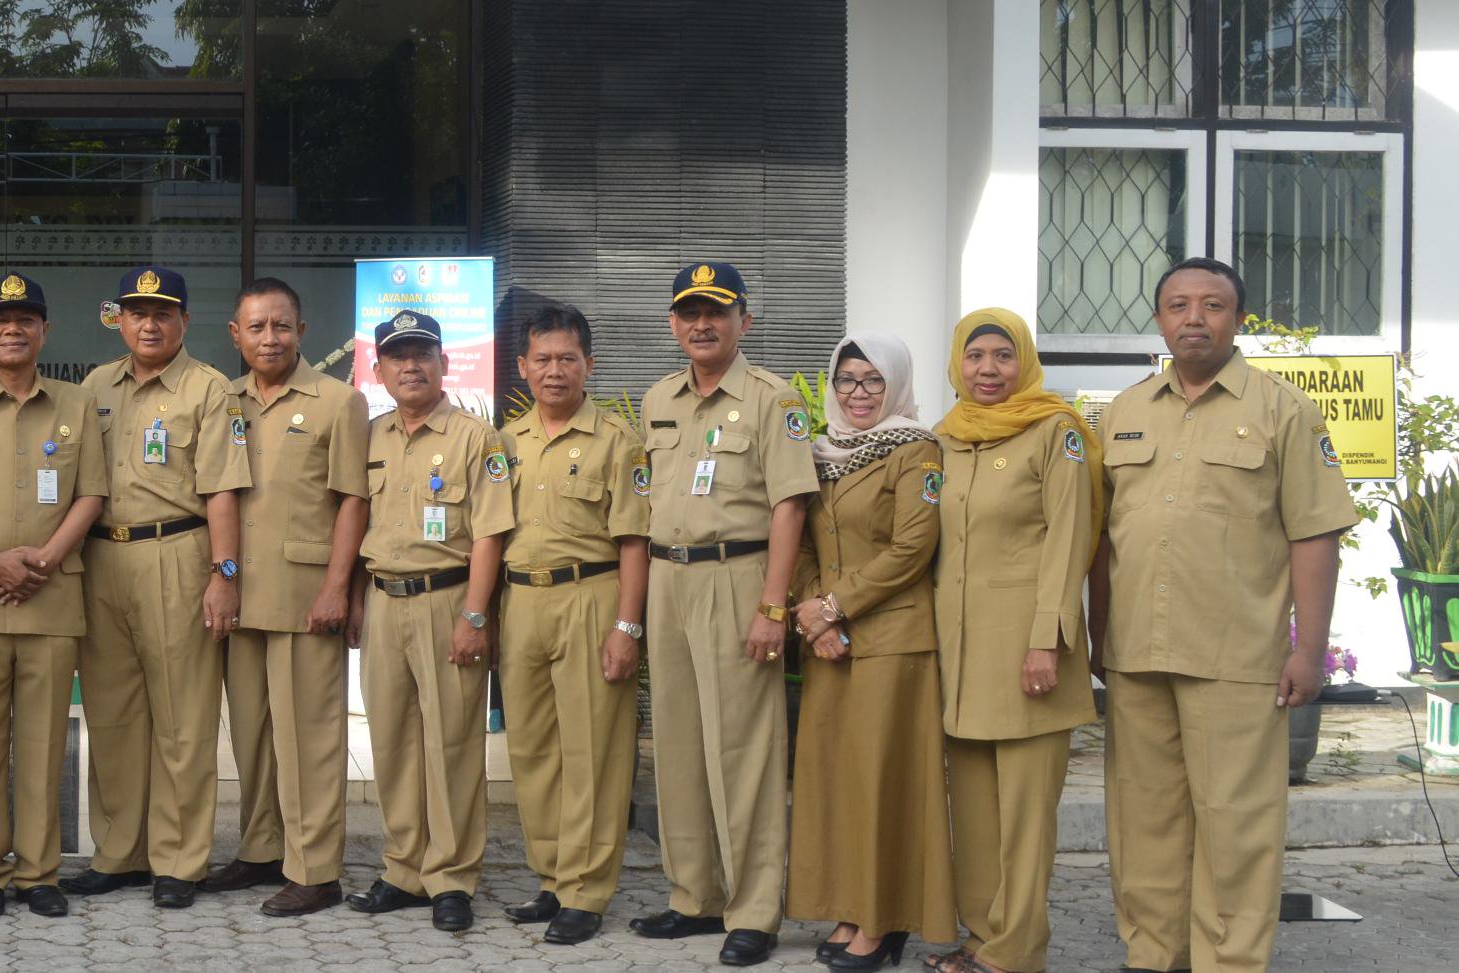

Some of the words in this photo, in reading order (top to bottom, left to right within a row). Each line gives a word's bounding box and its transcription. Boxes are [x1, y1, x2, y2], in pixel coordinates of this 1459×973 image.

[378, 292, 422, 303] LAYANAN
[361, 307, 381, 317] DAN
[384, 307, 446, 318] PENADUAN
[1275, 370, 1364, 393] NDARAAN
[1343, 398, 1384, 421] TAMU
